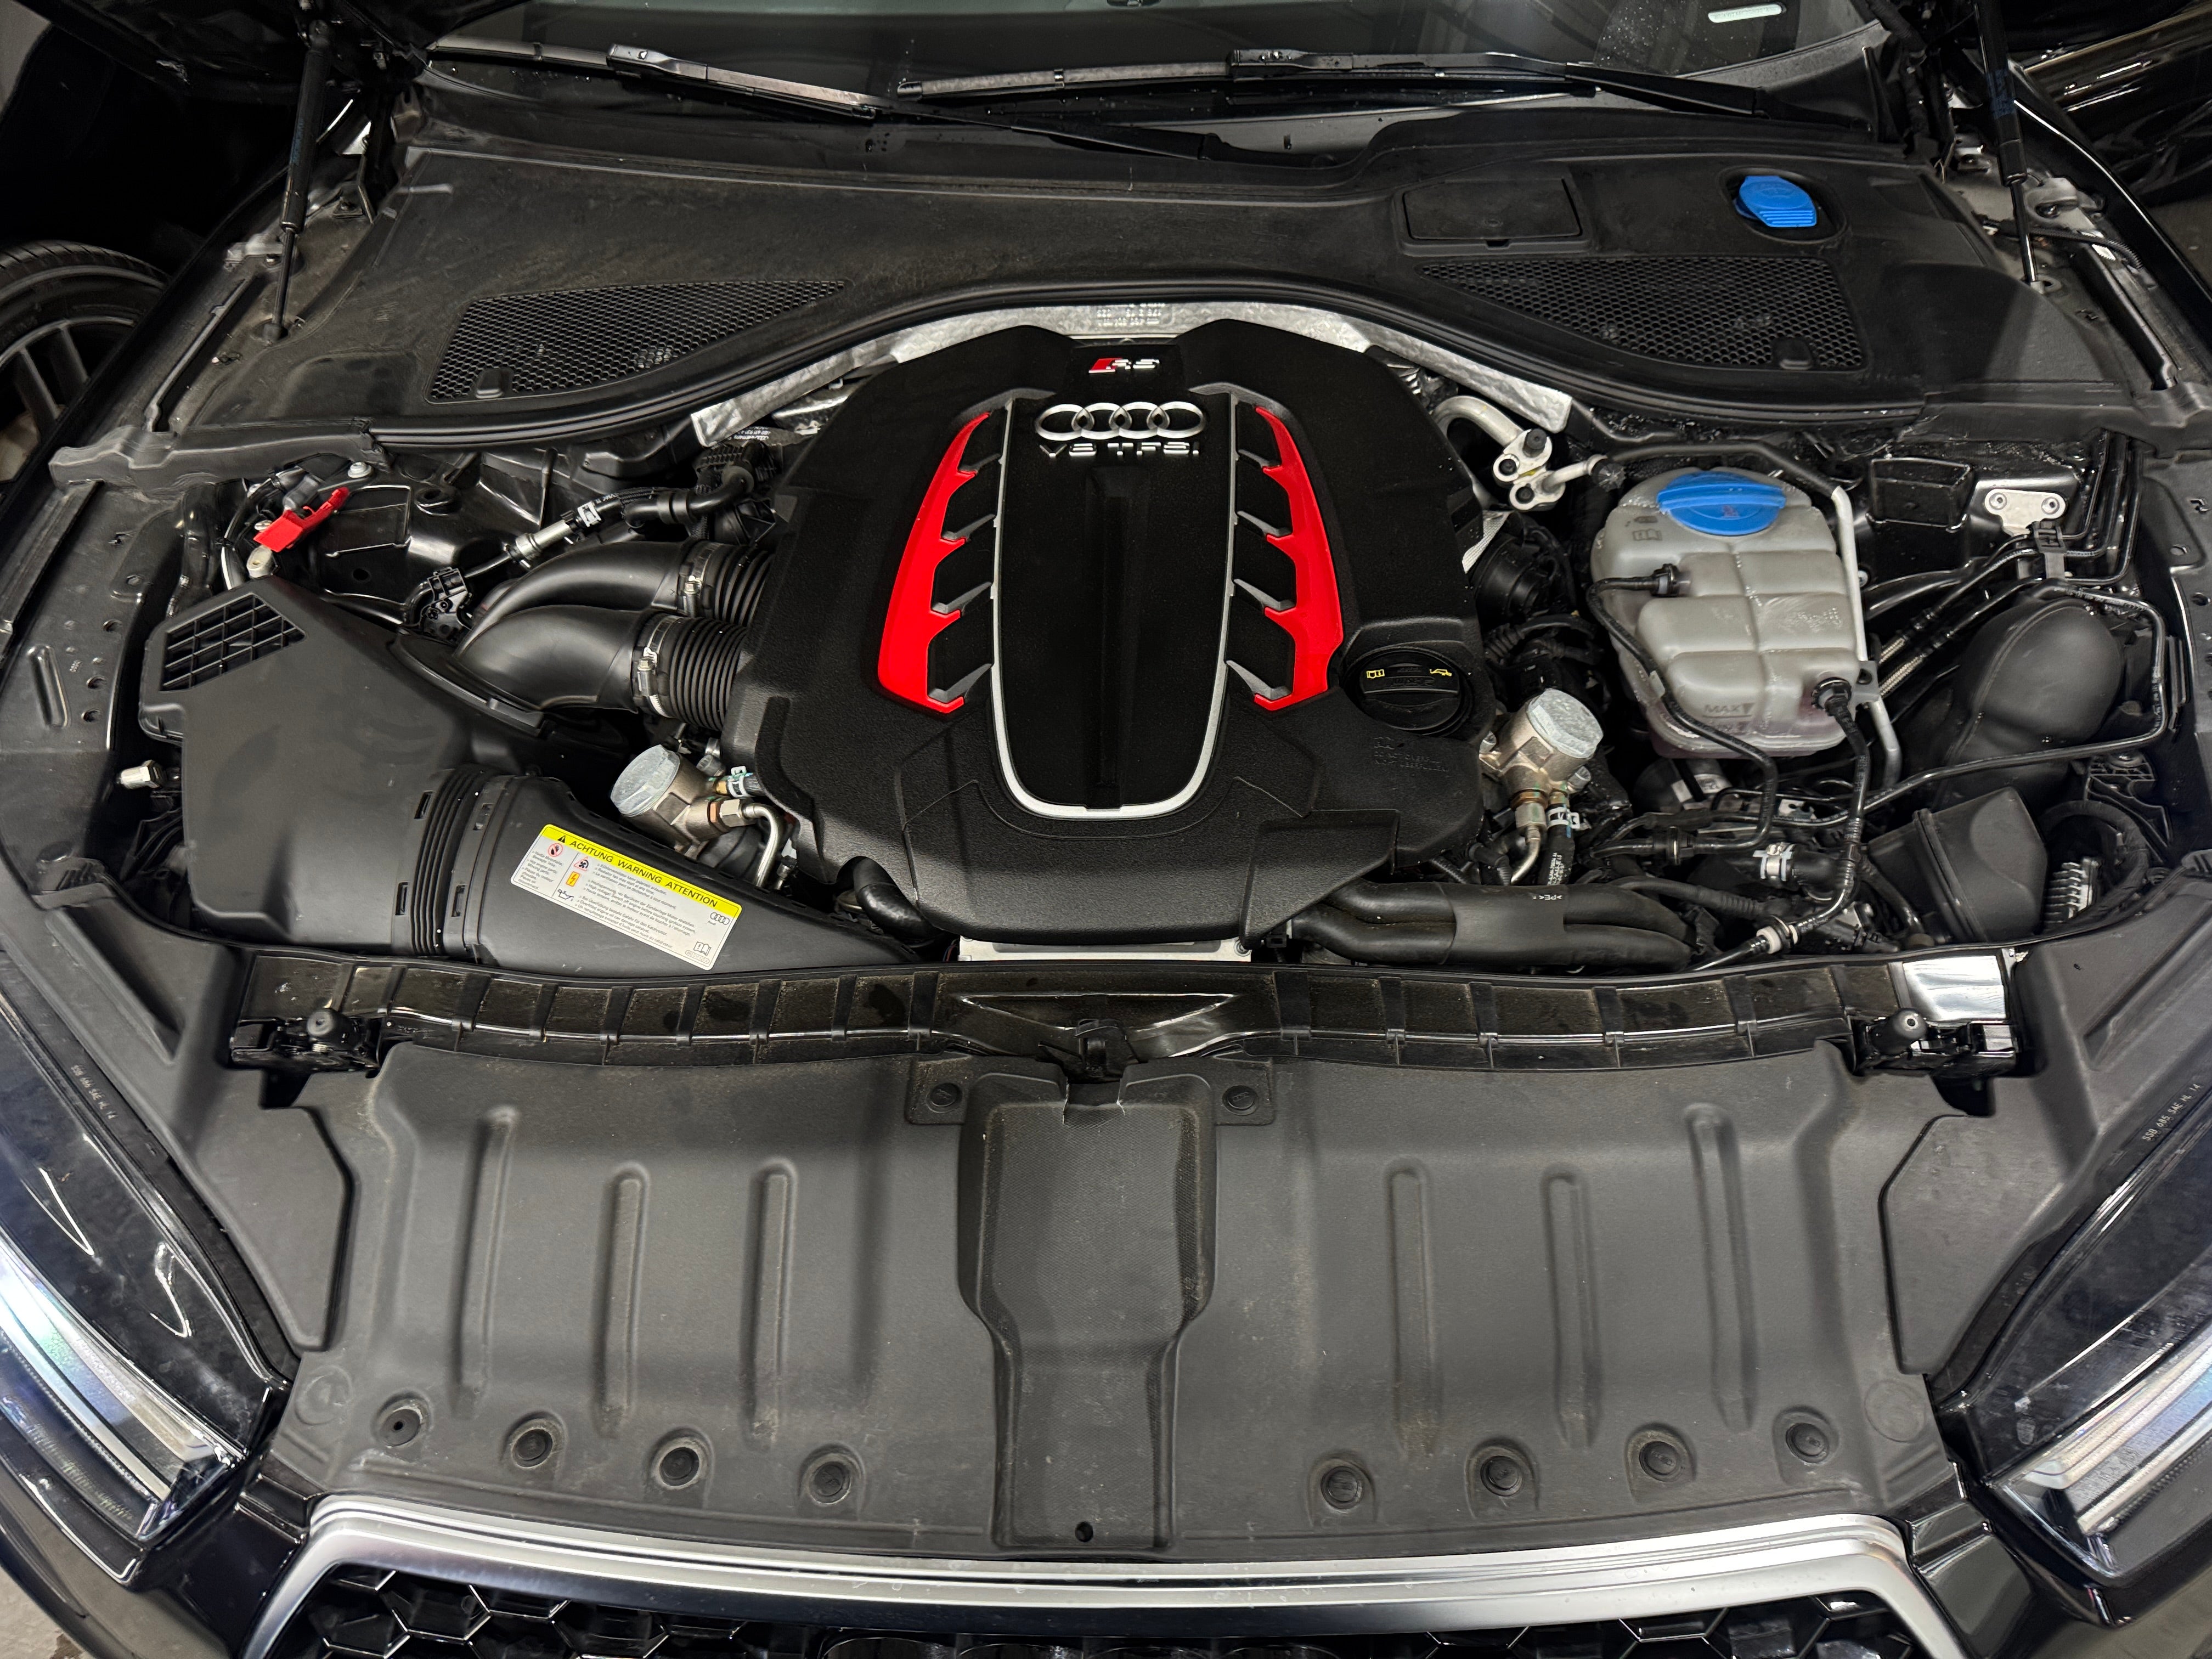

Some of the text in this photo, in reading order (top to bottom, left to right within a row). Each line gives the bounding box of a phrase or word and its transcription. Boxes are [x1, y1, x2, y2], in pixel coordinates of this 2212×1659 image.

[1040, 443, 1097, 456] V8
[1704, 704, 1741, 713] MAX
[569, 841, 718, 906] ACHTUNG WARNING ATTENTION
[88, 1089, 103, 1101] SAE
[2142, 1128, 2158, 1141] SSB
[2155, 1115, 2171, 1127] 685
[2168, 1102, 2183, 1114] SAE
